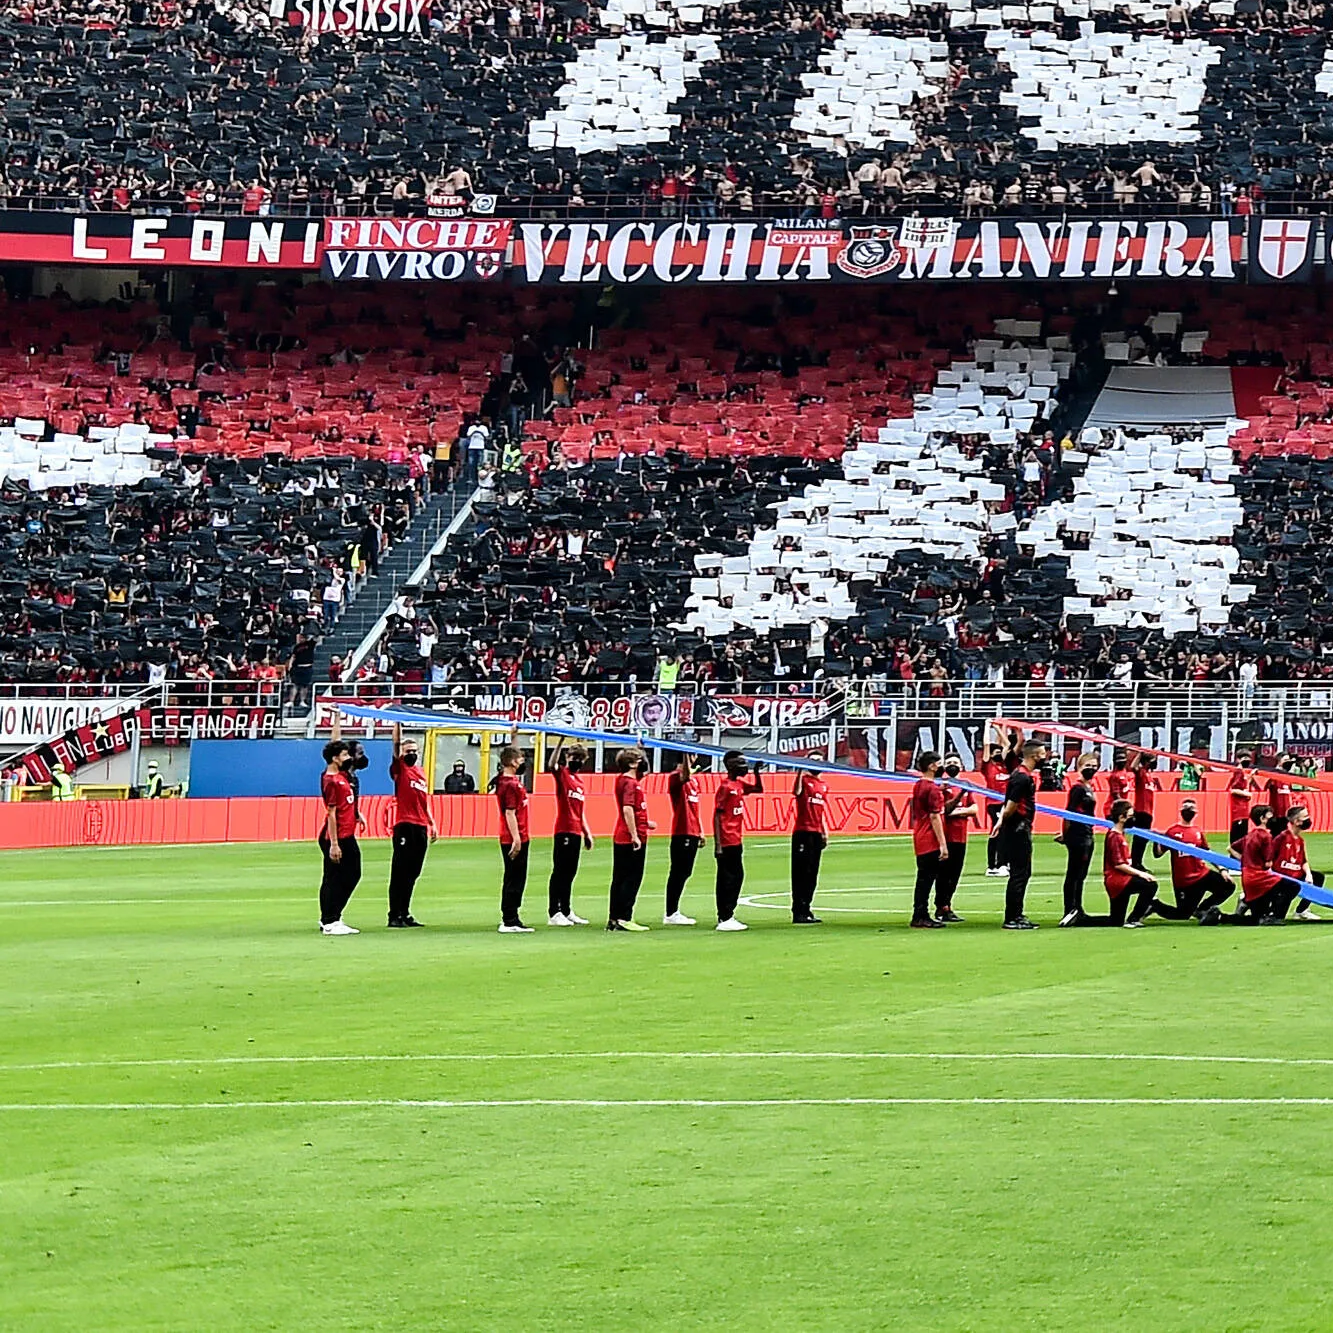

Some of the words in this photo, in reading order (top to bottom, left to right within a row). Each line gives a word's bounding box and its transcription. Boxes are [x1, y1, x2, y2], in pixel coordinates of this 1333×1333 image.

[774, 218, 827, 229] MILAN
[70, 216, 318, 264] LEONI
[519, 221, 833, 283] VECCHIA
[898, 220, 1235, 280] MANIERA
[771, 233, 840, 245] CAPITALE
